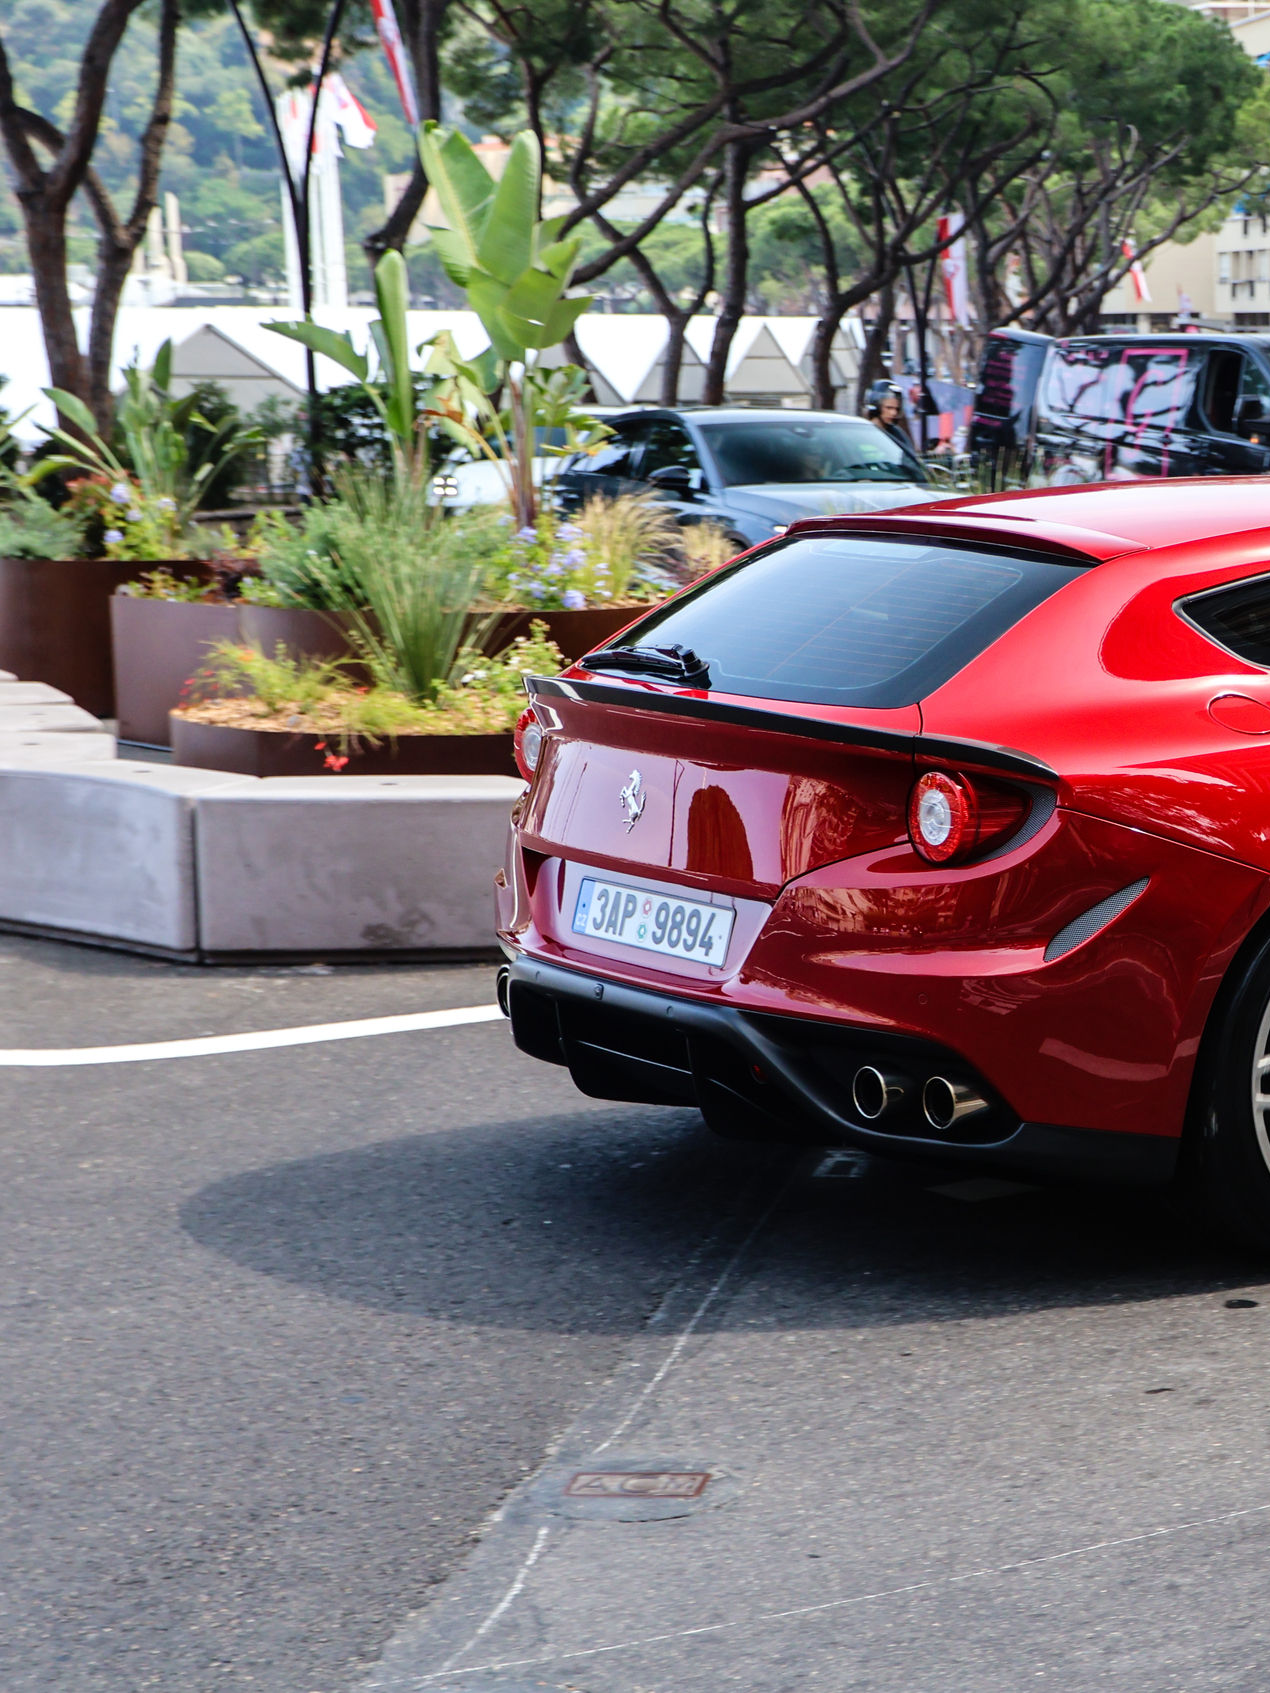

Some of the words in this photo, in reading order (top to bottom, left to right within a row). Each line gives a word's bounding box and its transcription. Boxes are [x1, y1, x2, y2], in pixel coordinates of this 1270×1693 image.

[575, 913, 587, 927] CZ
[592, 888, 638, 937] 3AP
[651, 901, 717, 957] 9894
